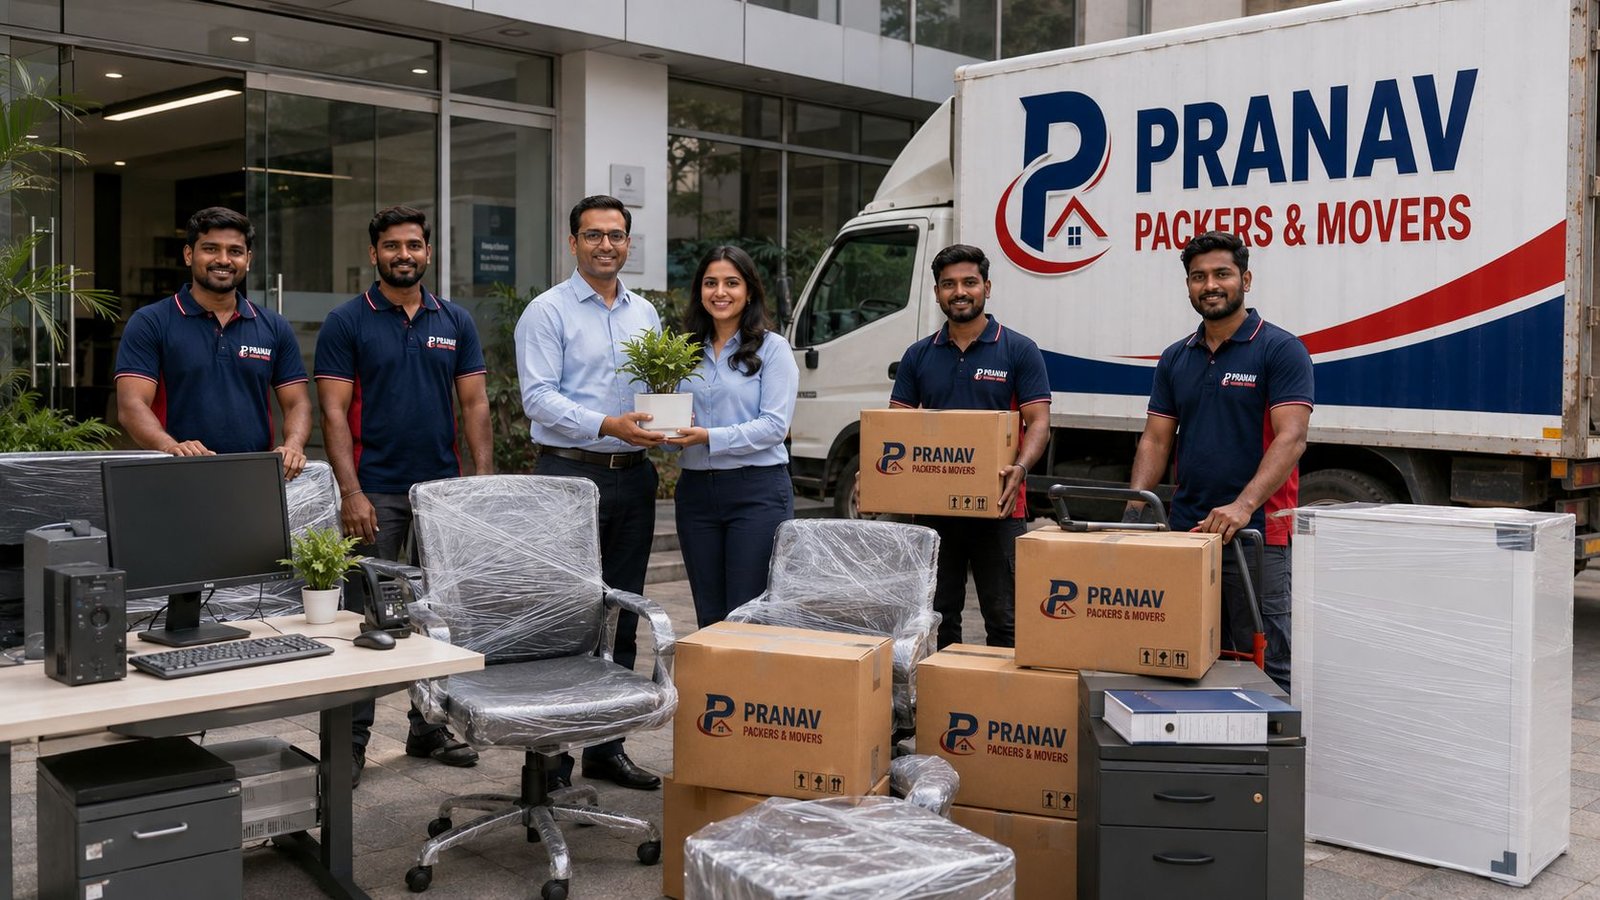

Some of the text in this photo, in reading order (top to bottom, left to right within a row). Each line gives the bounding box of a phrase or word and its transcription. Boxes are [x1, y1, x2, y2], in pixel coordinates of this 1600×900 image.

[1136, 68, 1479, 194] PRANAV
[1135, 193, 1472, 252] PACKERS & MOVERS
[912, 446, 975, 464] PRANAV
[912, 464, 976, 475] PACKERS & MOVERS
[1087, 586, 1165, 609] PRANAV
[1086, 608, 1166, 623] PACKERS & MOVERS
[744, 702, 822, 730] PRANAV
[743, 726, 823, 745] PACKERS & MOVERS
[988, 720, 1068, 748] PRANAV
[987, 744, 1069, 764] PACKERS & MOVERS
